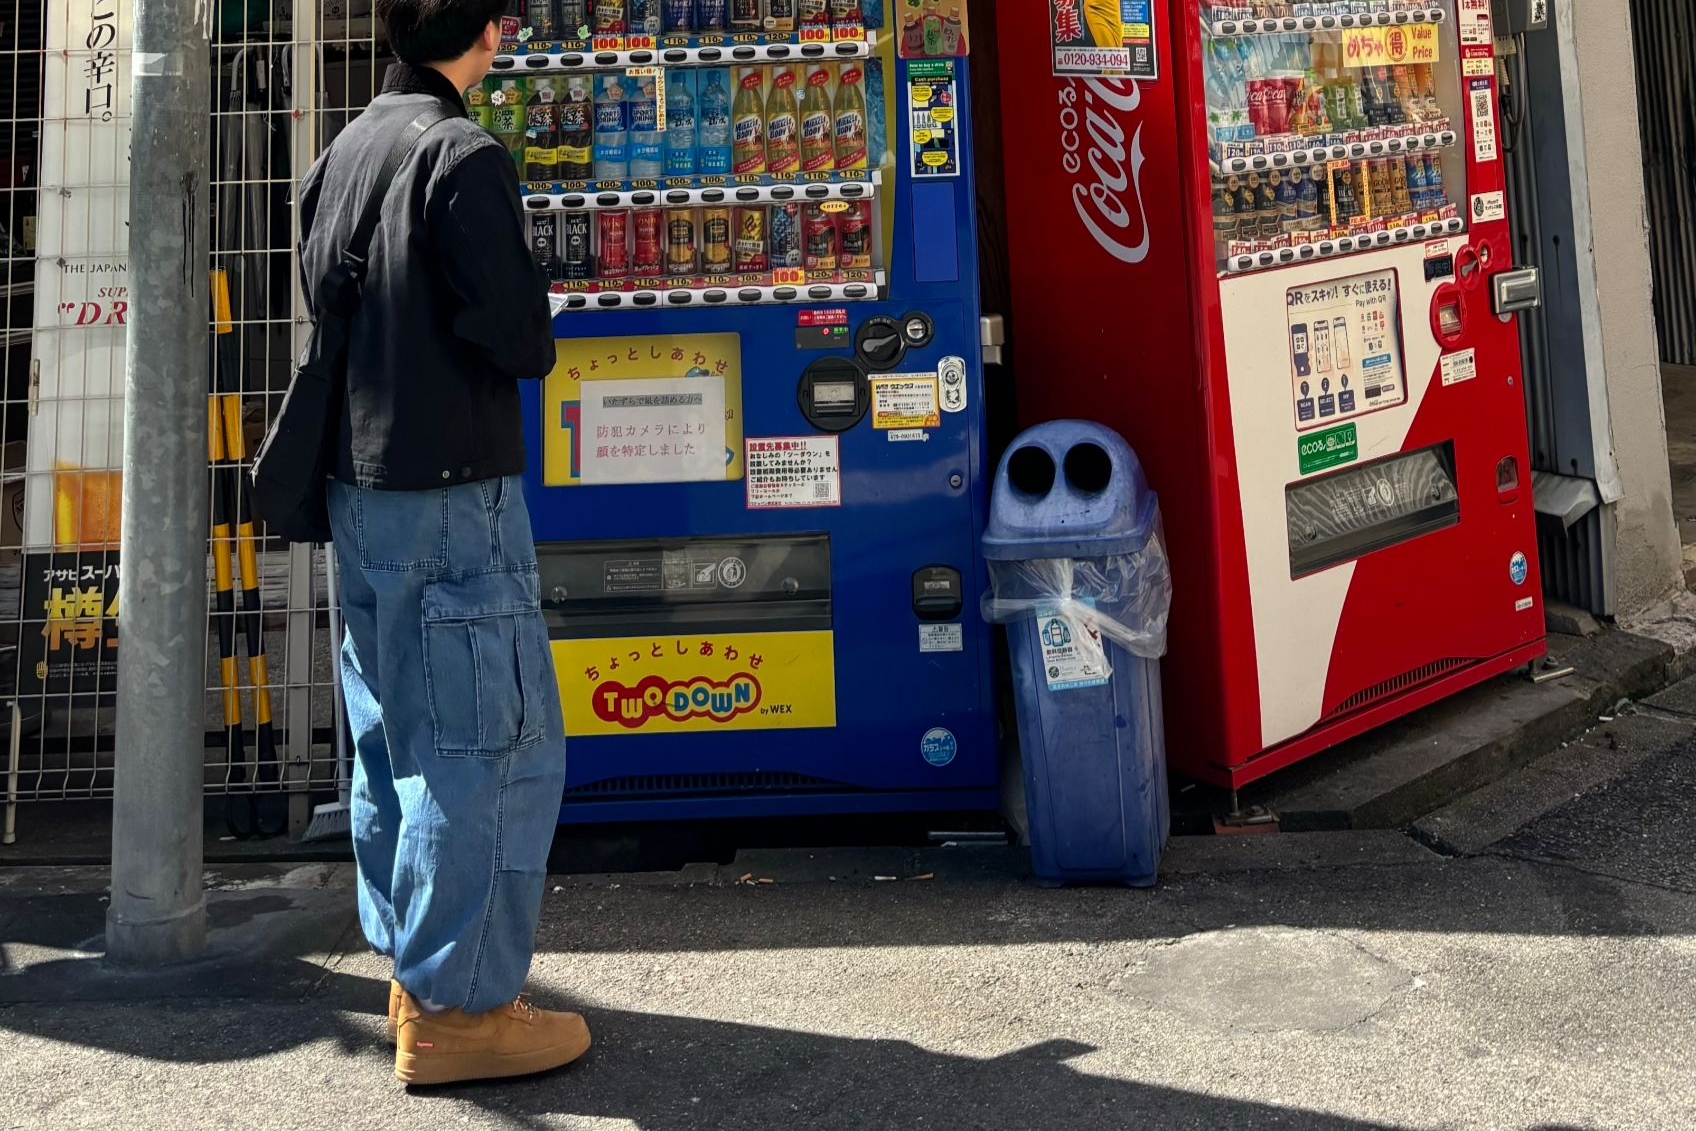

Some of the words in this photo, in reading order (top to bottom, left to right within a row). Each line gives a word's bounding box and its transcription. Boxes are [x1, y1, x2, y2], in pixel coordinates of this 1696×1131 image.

[1411, 26, 1432, 40] Value
[1346, 35, 1384, 58] めちゃ
[1389, 32, 1403, 56] 得
[1412, 46, 1433, 59] Price
[599, 115, 619, 123] DRINK
[634, 115, 654, 123] DRINK
[735, 117, 759, 132] MIRACLE
[768, 117, 793, 132] MIRACLE
[802, 115, 826, 130] MIRACLE
[835, 114, 859, 129] MIRACLE
[736, 128, 753, 140] BODY
[769, 128, 786, 140] BODY
[804, 126, 821, 138] BODY
[837, 125, 853, 137] BODY
[64, 263, 86, 275] THE
[1287, 285, 1338, 307] QRをスキャン!
[1341, 277, 1392, 298] すぐに使える!
[1355, 299, 1365, 308] Pay
[1365, 297, 1377, 306] with
[1377, 296, 1387, 304] QR
[566, 345, 728, 381] ちょっとしあわせ
[603, 394, 702, 406] いたずらで紙を詰める方へ
[596, 423, 706, 439] 防犯カメラにより
[596, 442, 696, 459] 顔を特定しました
[749, 440, 807, 452] 設置先募集中!!
[41, 585, 120, 651] 樽
[584, 640, 764, 682] ちょっとしあわせ
[603, 685, 663, 719] TWO
[673, 682, 750, 714] DOWN
[760, 707, 769, 716] by
[769, 704, 793, 715] WEX
